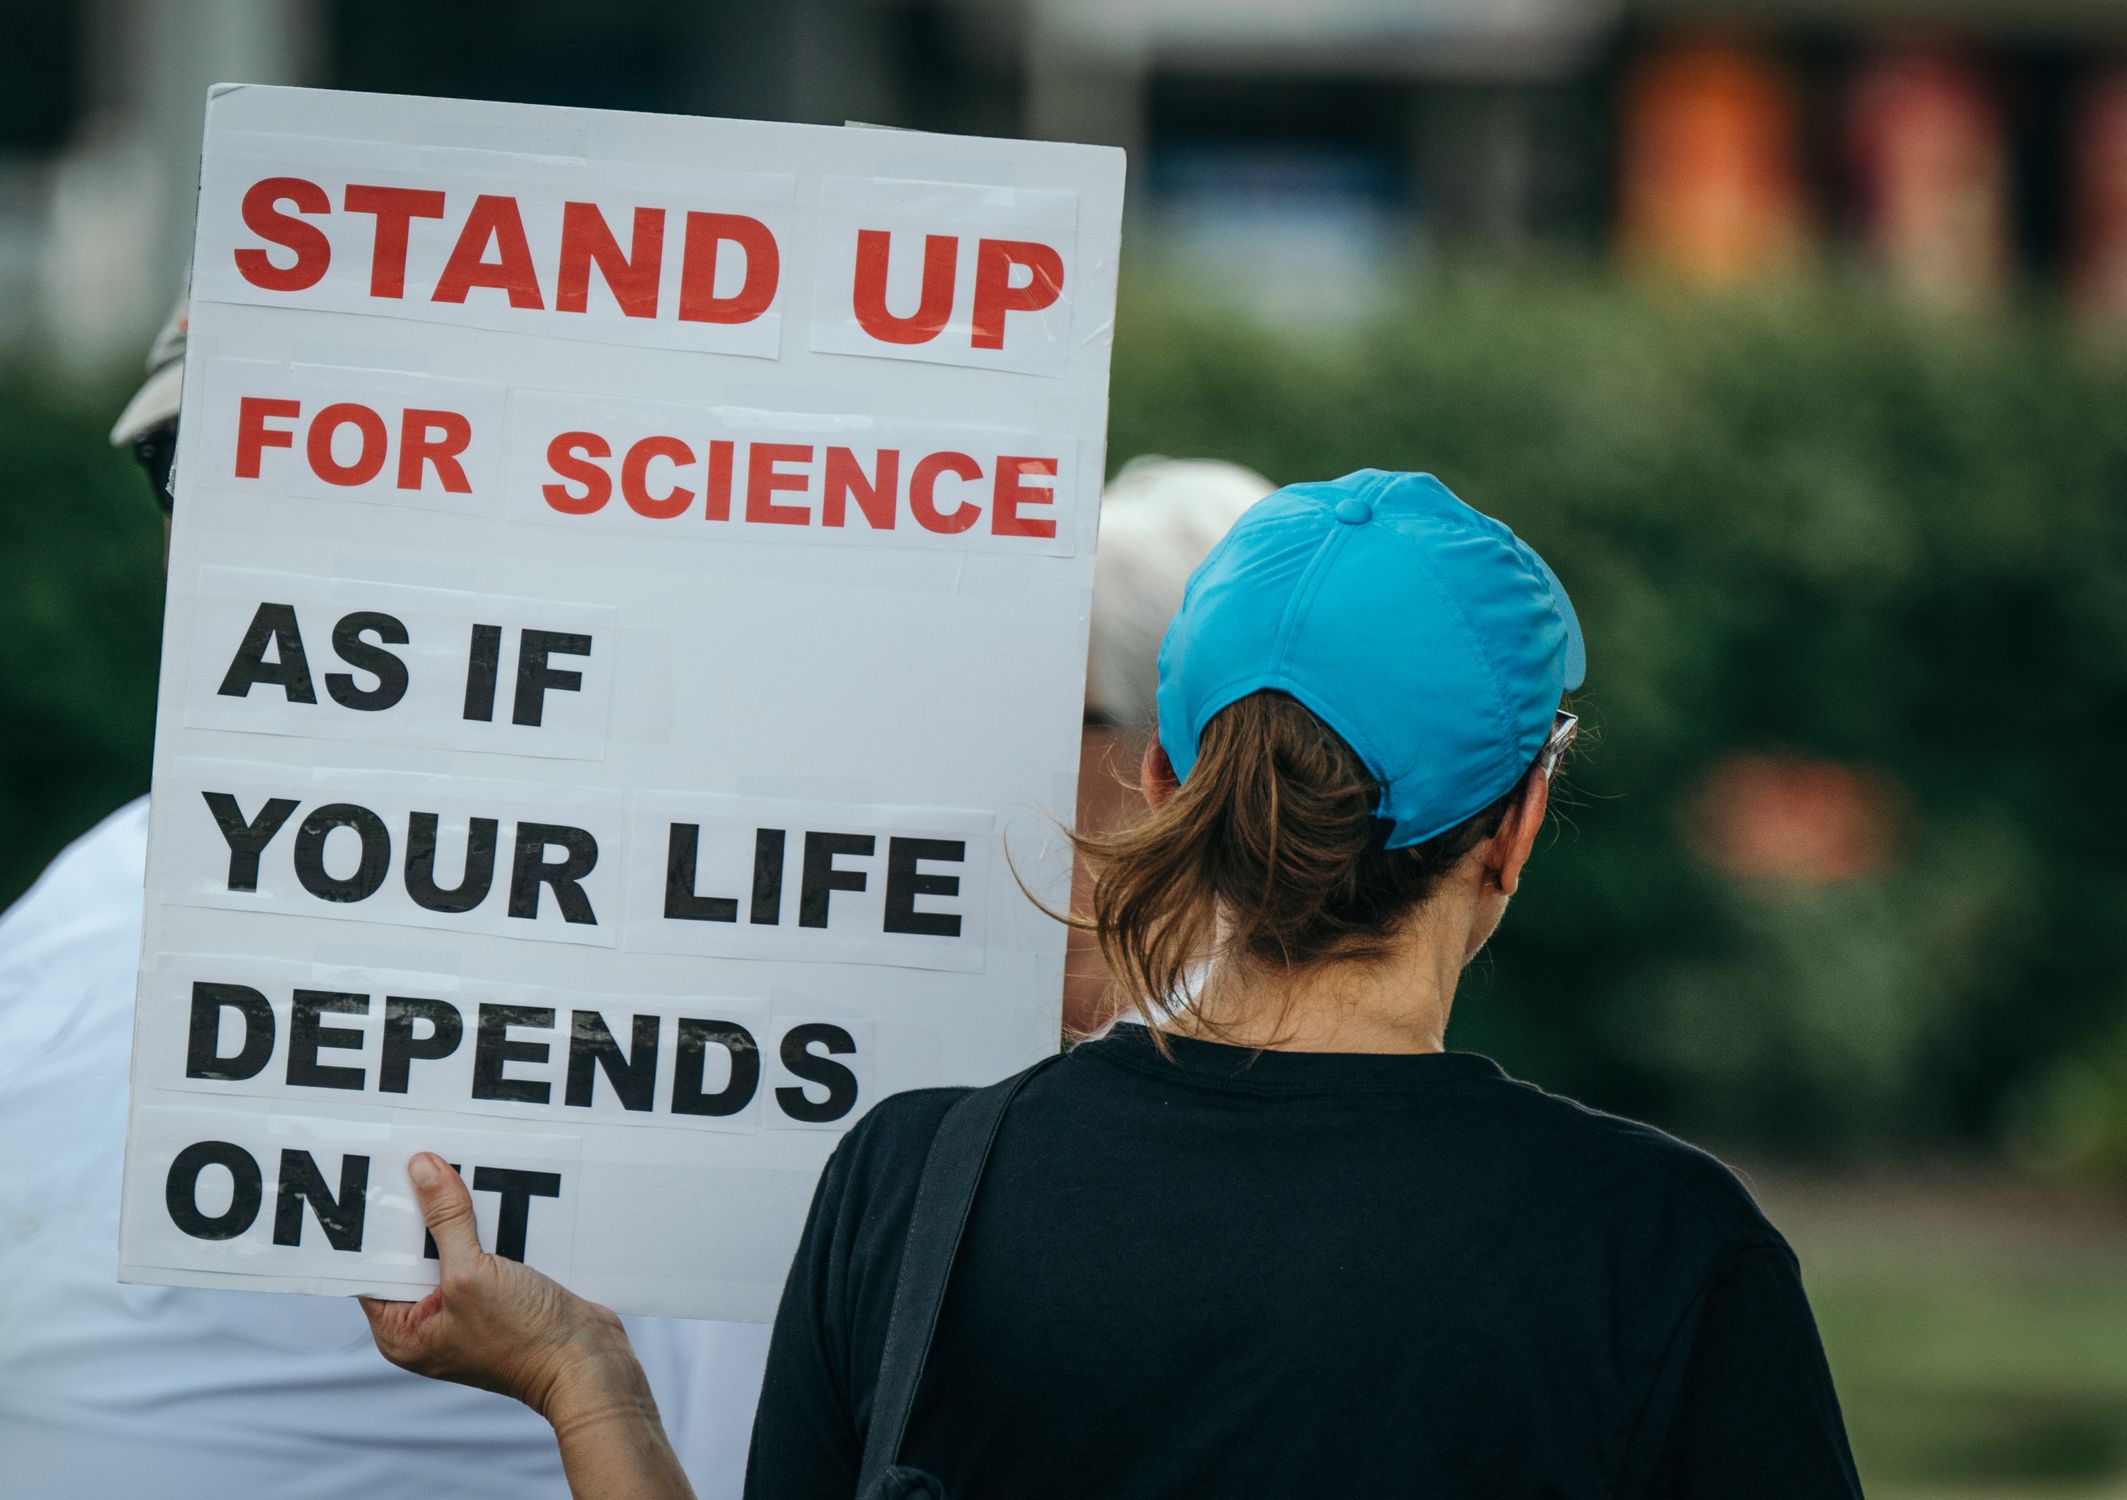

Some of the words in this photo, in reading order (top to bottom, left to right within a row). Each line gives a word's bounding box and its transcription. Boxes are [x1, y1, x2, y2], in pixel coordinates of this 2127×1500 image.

[236, 179, 778, 324] STAND
[854, 230, 1063, 349] UP
[236, 398, 471, 492] FOR
[543, 432, 1056, 537] SCIENCE
[217, 603, 409, 711] AS
[463, 624, 592, 727] IF
[202, 792, 598, 925] YOUR
[664, 823, 965, 937] LIFE
[186, 982, 857, 1122] DEPENDS
[166, 1141, 369, 1252] ON
[424, 1164, 561, 1264] T
